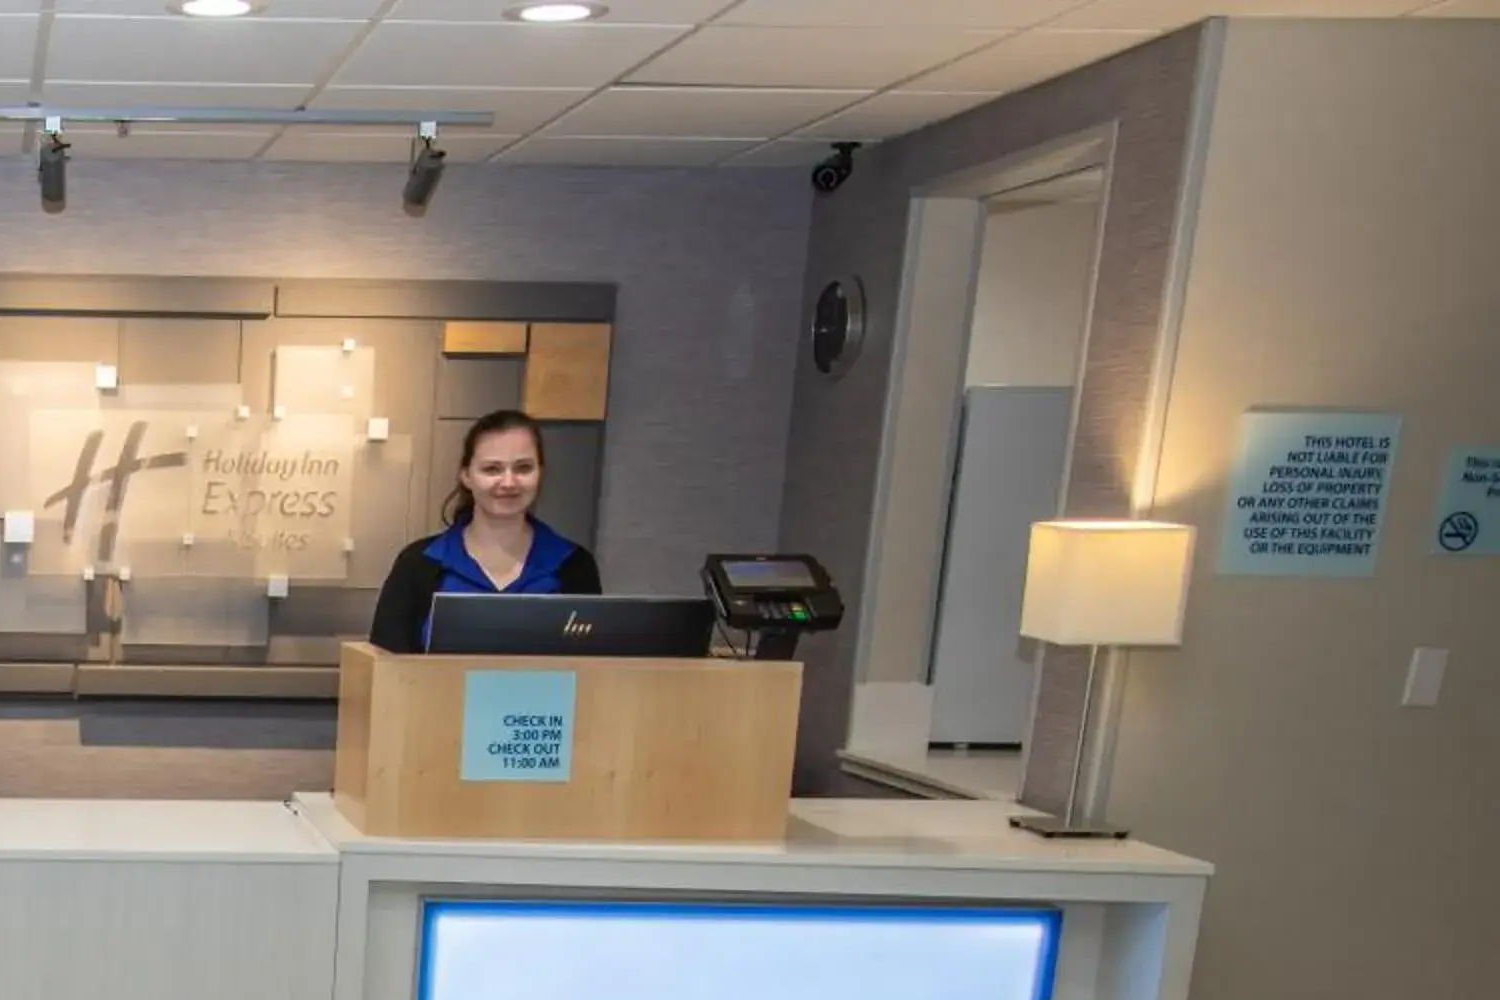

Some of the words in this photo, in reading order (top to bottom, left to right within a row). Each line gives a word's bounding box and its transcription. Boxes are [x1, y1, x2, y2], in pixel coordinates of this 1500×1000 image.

[1304, 435, 1332, 448] THIS
[1335, 436, 1374, 449] HOTEL
[1379, 437, 1391, 449] IS
[202, 450, 299, 480] Holiday
[300, 450, 340, 475] Inn
[1287, 451, 1314, 463] NOT
[1316, 452, 1358, 464] LIABLE
[1360, 453, 1388, 465] FOR
[1269, 465, 1334, 478] PERSONAL
[1338, 467, 1382, 479] INJURY
[1263, 481, 1293, 493] LOSS
[1296, 482, 1314, 493] OF
[1316, 482, 1382, 495] PROPERTY
[202, 482, 338, 520] Express
[1237, 496, 1255, 508] OR
[1258, 497, 1285, 509] ANY
[1287, 498, 1329, 509] OTHER
[1331, 498, 1379, 510] CLAIMS
[1250, 512, 1300, 524] ARISING
[1302, 513, 1331, 525] OUT
[1332, 513, 1348, 525] OF
[1353, 513, 1376, 525] THE
[1244, 527, 1268, 539] USE
[1270, 527, 1289, 539] OF
[1290, 528, 1317, 539] THIS
[1320, 528, 1374, 541] FACILITY
[1250, 542, 1268, 554] OR
[1272, 542, 1294, 554] THE
[1297, 543, 1372, 556] EQUIPMENT
[503, 715, 546, 727] CHECK
[549, 715, 563, 727] IN
[512, 729, 539, 741] 3:00
[542, 729, 562, 741] PM
[487, 743, 531, 755] CHECK
[533, 743, 560, 755] OUT
[503, 757, 536, 769] 11:00
[538, 757, 560, 769] AM
